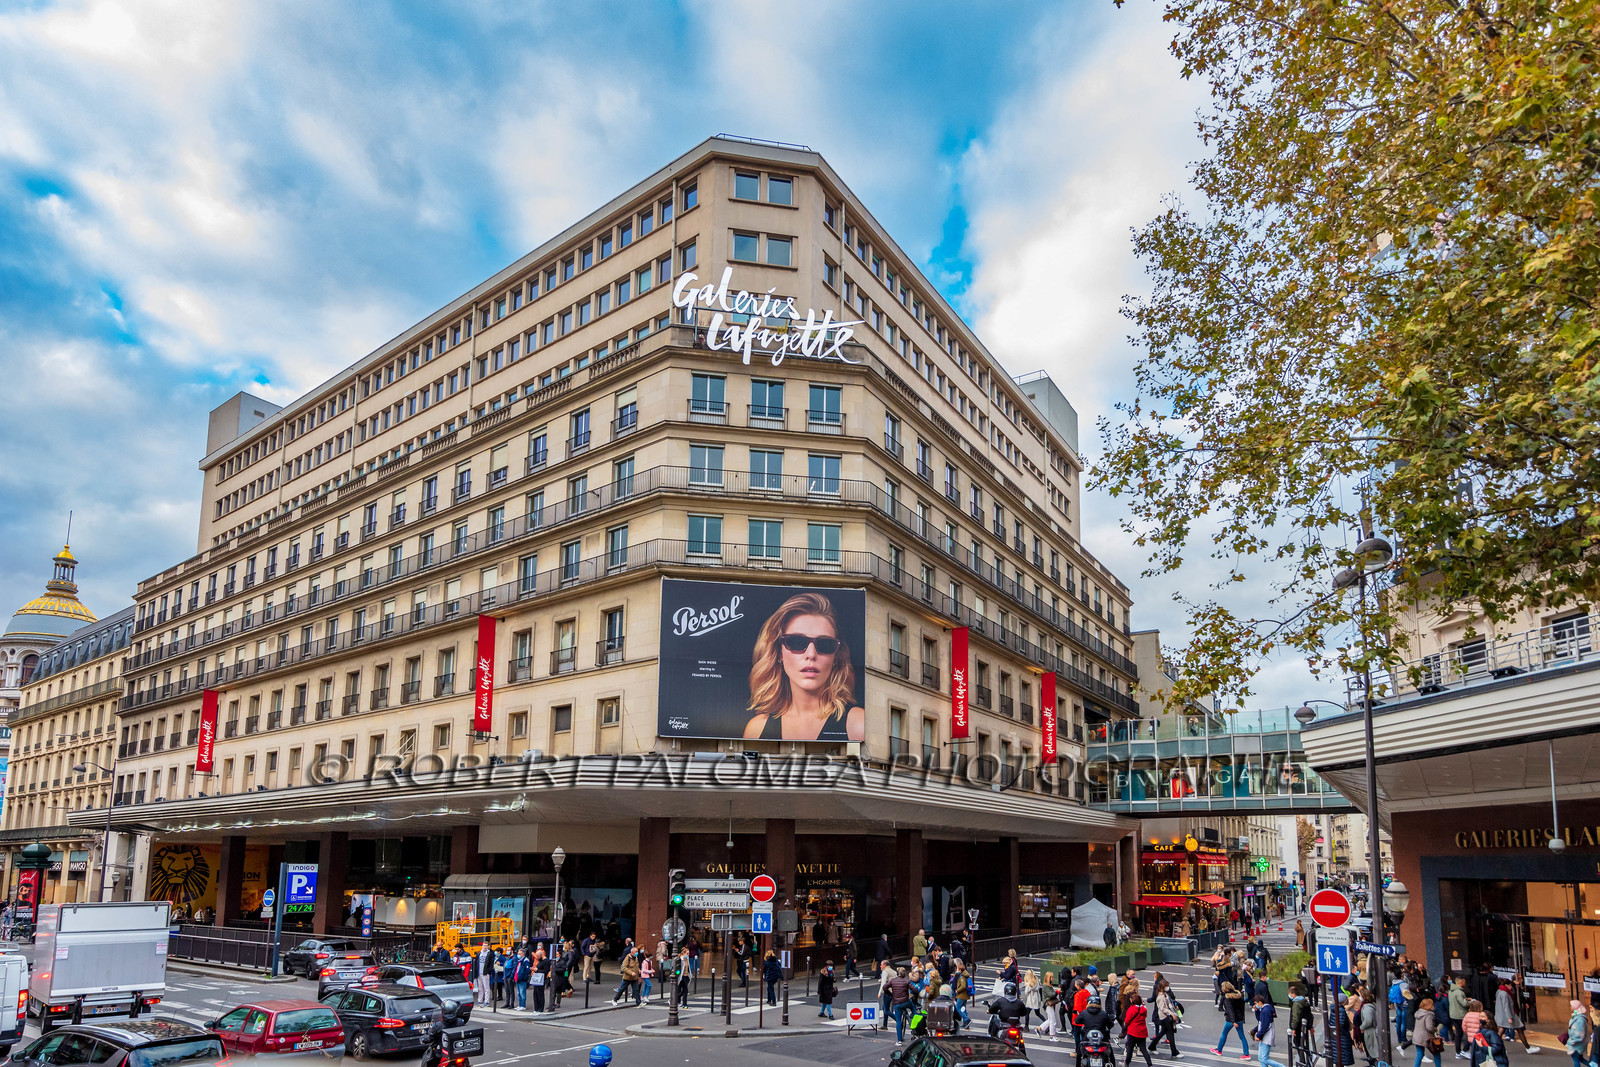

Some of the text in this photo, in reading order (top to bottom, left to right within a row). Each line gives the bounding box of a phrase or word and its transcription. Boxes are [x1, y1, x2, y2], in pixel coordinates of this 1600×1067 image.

[672, 266, 801, 321] Galeries
[706, 308, 865, 366] Lafayette
[672, 595, 745, 637] Persol
[477, 655, 492, 720] Galeries Lafayette
[953, 667, 967, 727] Galeries Lafayette
[1455, 828, 1556, 848] GALERIES
[70, 861, 86, 870] MANGO
[706, 863, 766, 874] GALERIES
[291, 874, 308, 894] P
[1355, 941, 1381, 953] Toilettes
